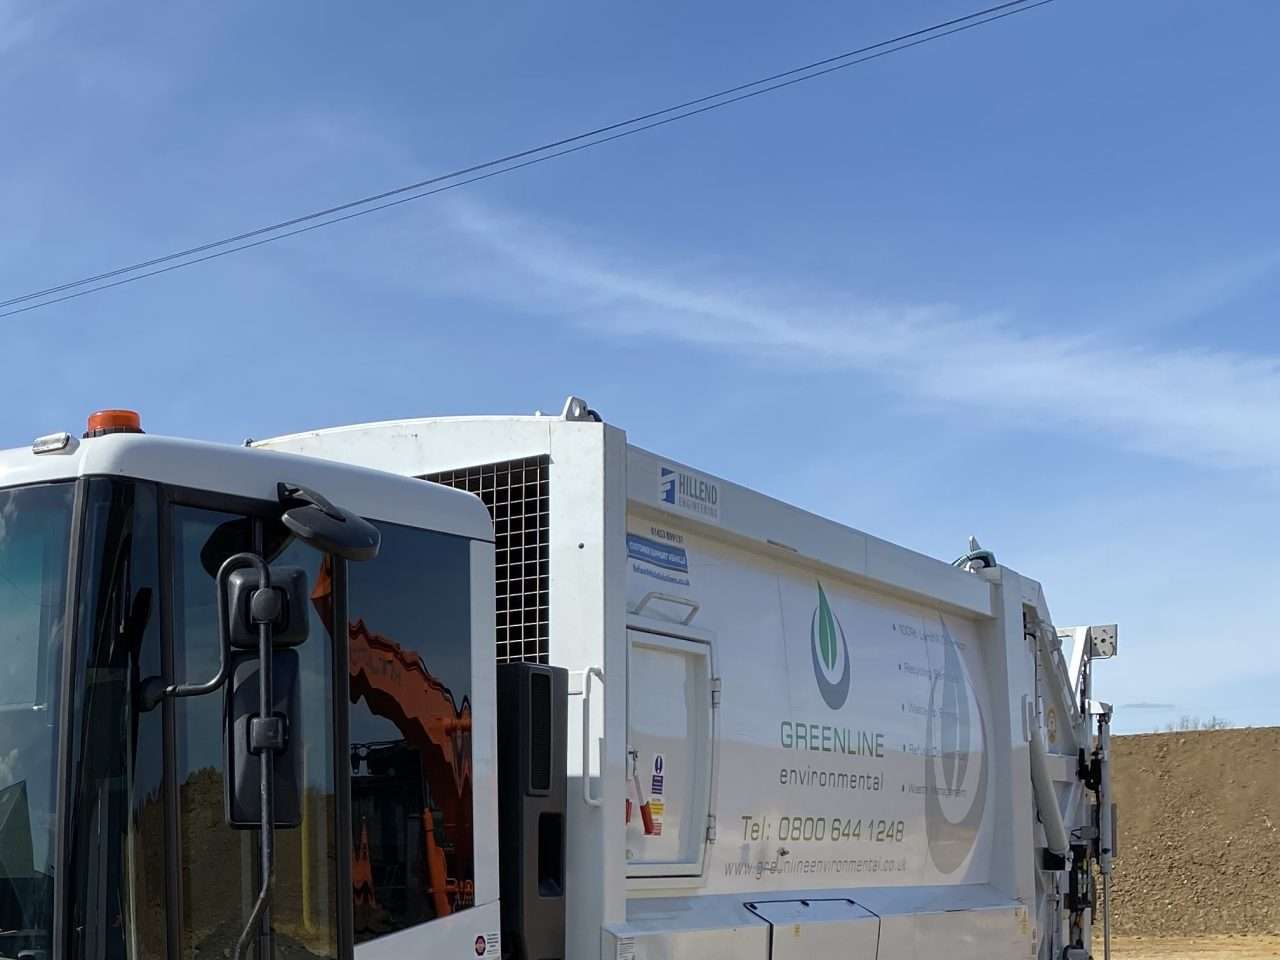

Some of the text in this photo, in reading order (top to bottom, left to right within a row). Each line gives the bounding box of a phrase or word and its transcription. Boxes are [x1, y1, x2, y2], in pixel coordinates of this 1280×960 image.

[679, 473, 718, 505] HILLEND
[780, 721, 885, 758] GREENLINE
[780, 764, 884, 791] environmental
[741, 816, 905, 842] Tel: 0800 644 1248
